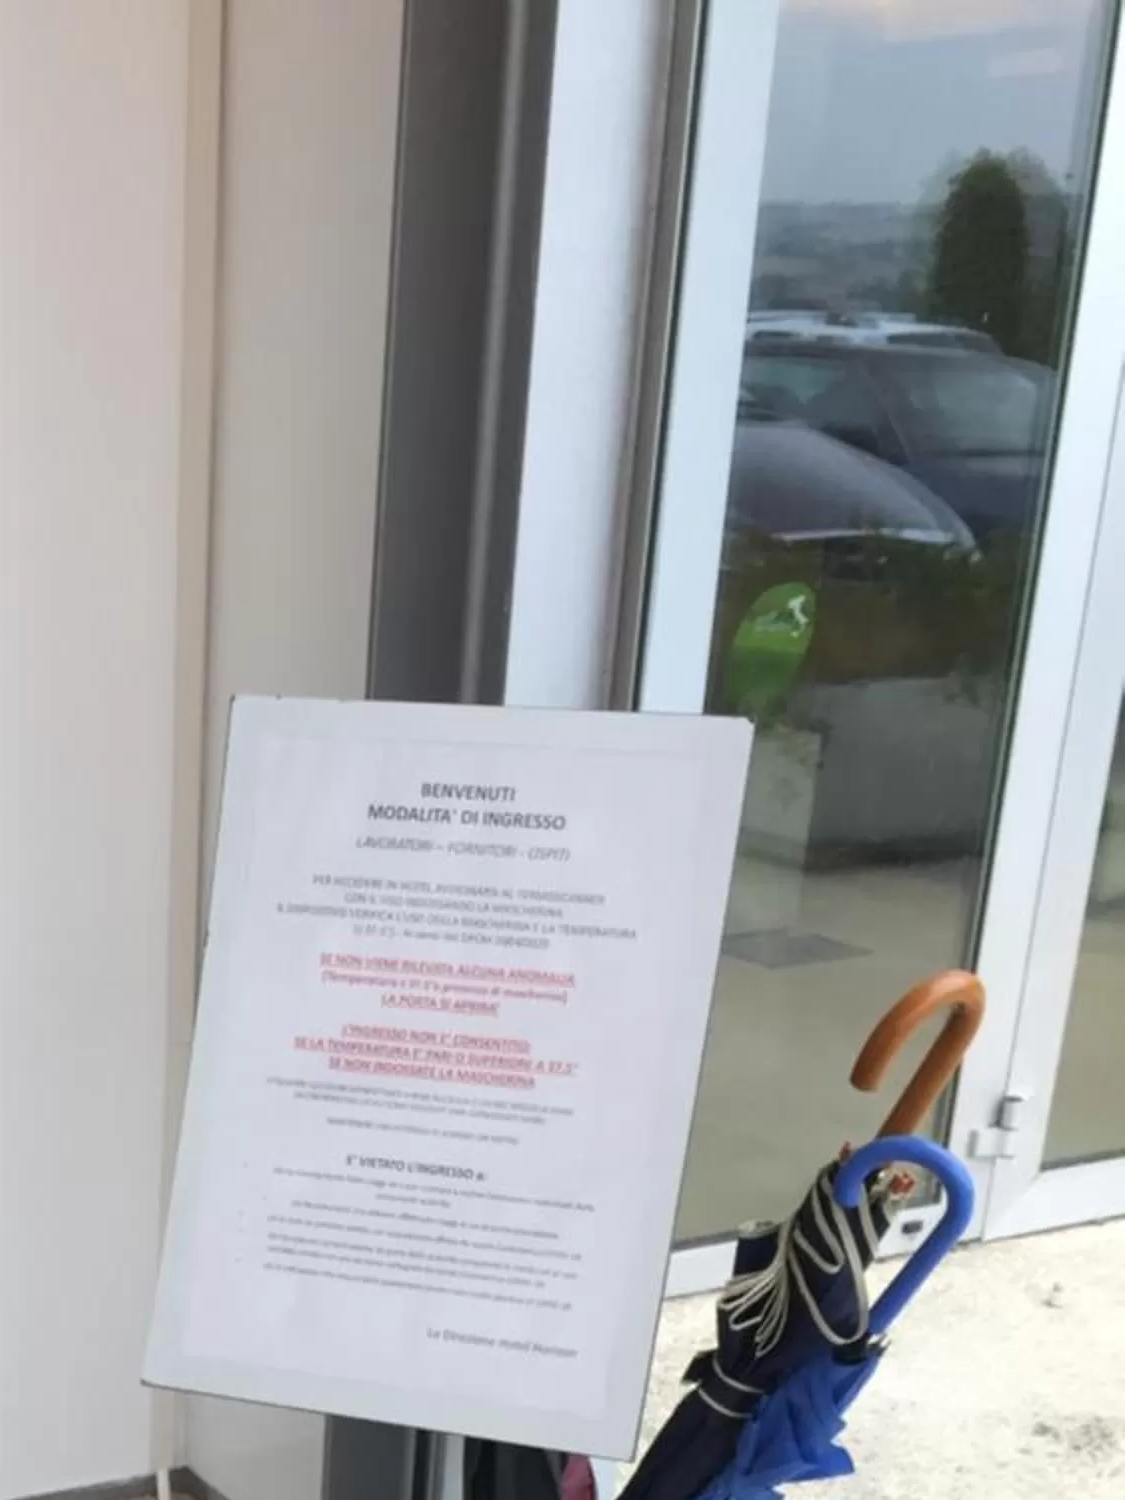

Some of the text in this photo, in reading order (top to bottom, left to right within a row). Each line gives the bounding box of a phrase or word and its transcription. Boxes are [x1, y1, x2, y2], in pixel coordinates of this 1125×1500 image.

[421, 782, 516, 802] BENVENUTI
[367, 804, 567, 830] MODALITA' DI INGRESSO
[356, 836, 433, 853] LAVORATORI
[447, 841, 518, 858] FORNITORI
[559, 924, 637, 939] TEMPERATURA
[335, 954, 364, 970] NON
[366, 957, 400, 972] VIENE
[457, 963, 505, 980] ALCUNA
[399, 995, 436, 1011] PORTA
[410, 1029, 437, 1045] NON
[328, 1038, 410, 1060] TEMPERATURA
[467, 1053, 533, 1073] SUPERIORE
[343, 1058, 372, 1074] NON
[456, 1069, 536, 1090] MASCHERINA
[359, 1156, 405, 1172] VIETATO
[407, 1162, 474, 1181] L'INGRESSO
